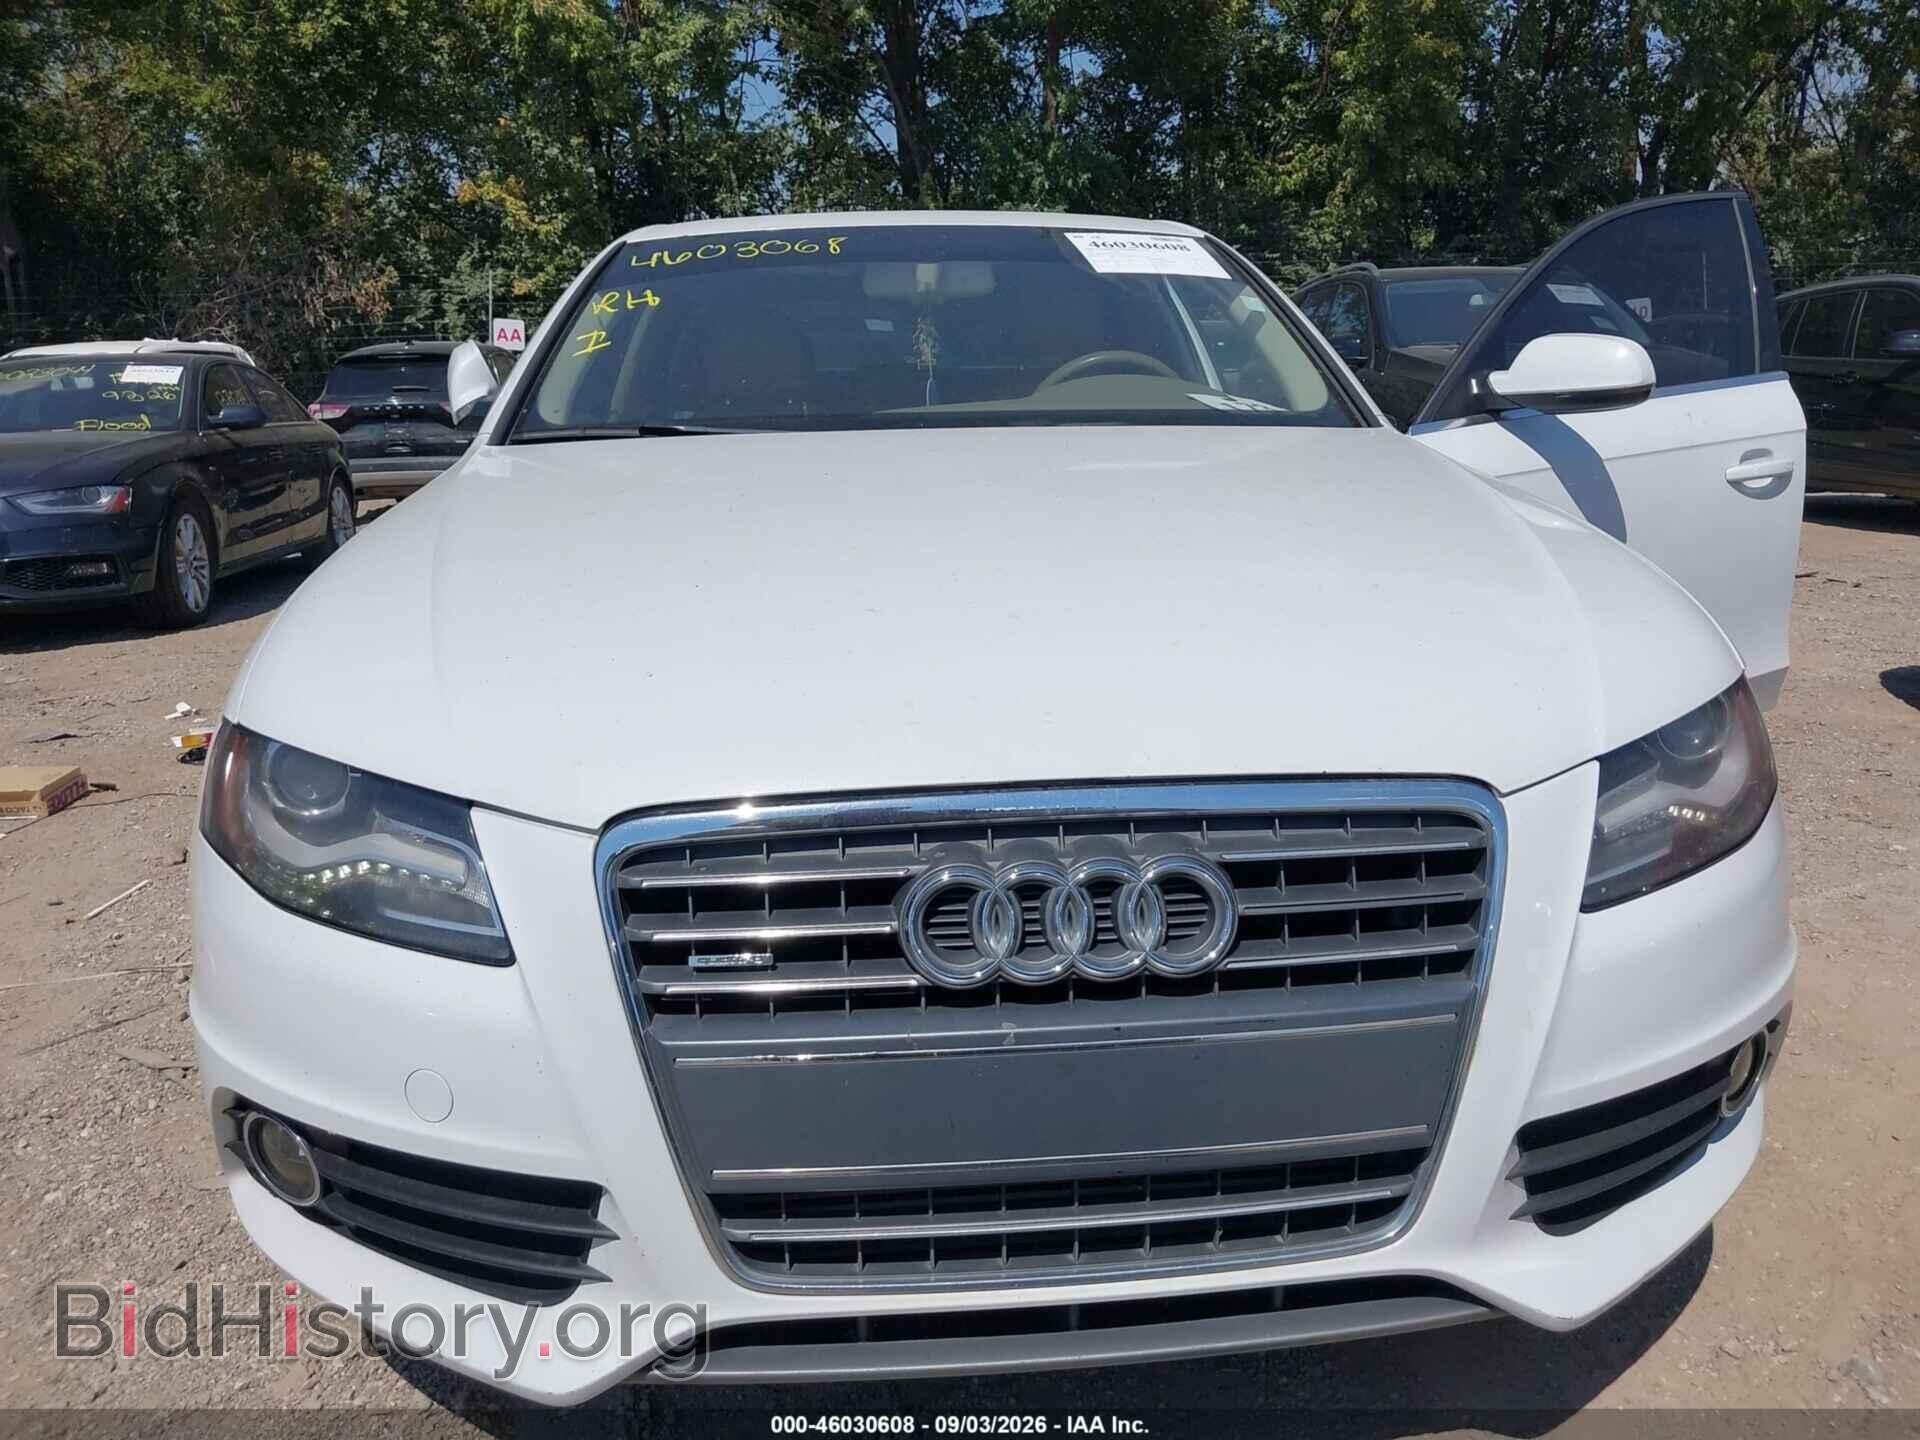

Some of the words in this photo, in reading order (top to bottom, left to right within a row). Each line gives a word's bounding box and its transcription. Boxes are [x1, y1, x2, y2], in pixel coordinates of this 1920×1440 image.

[1089, 240, 1192, 252] 46030608
[496, 327, 522, 343] AA
[74, 413, 151, 431] Flood
